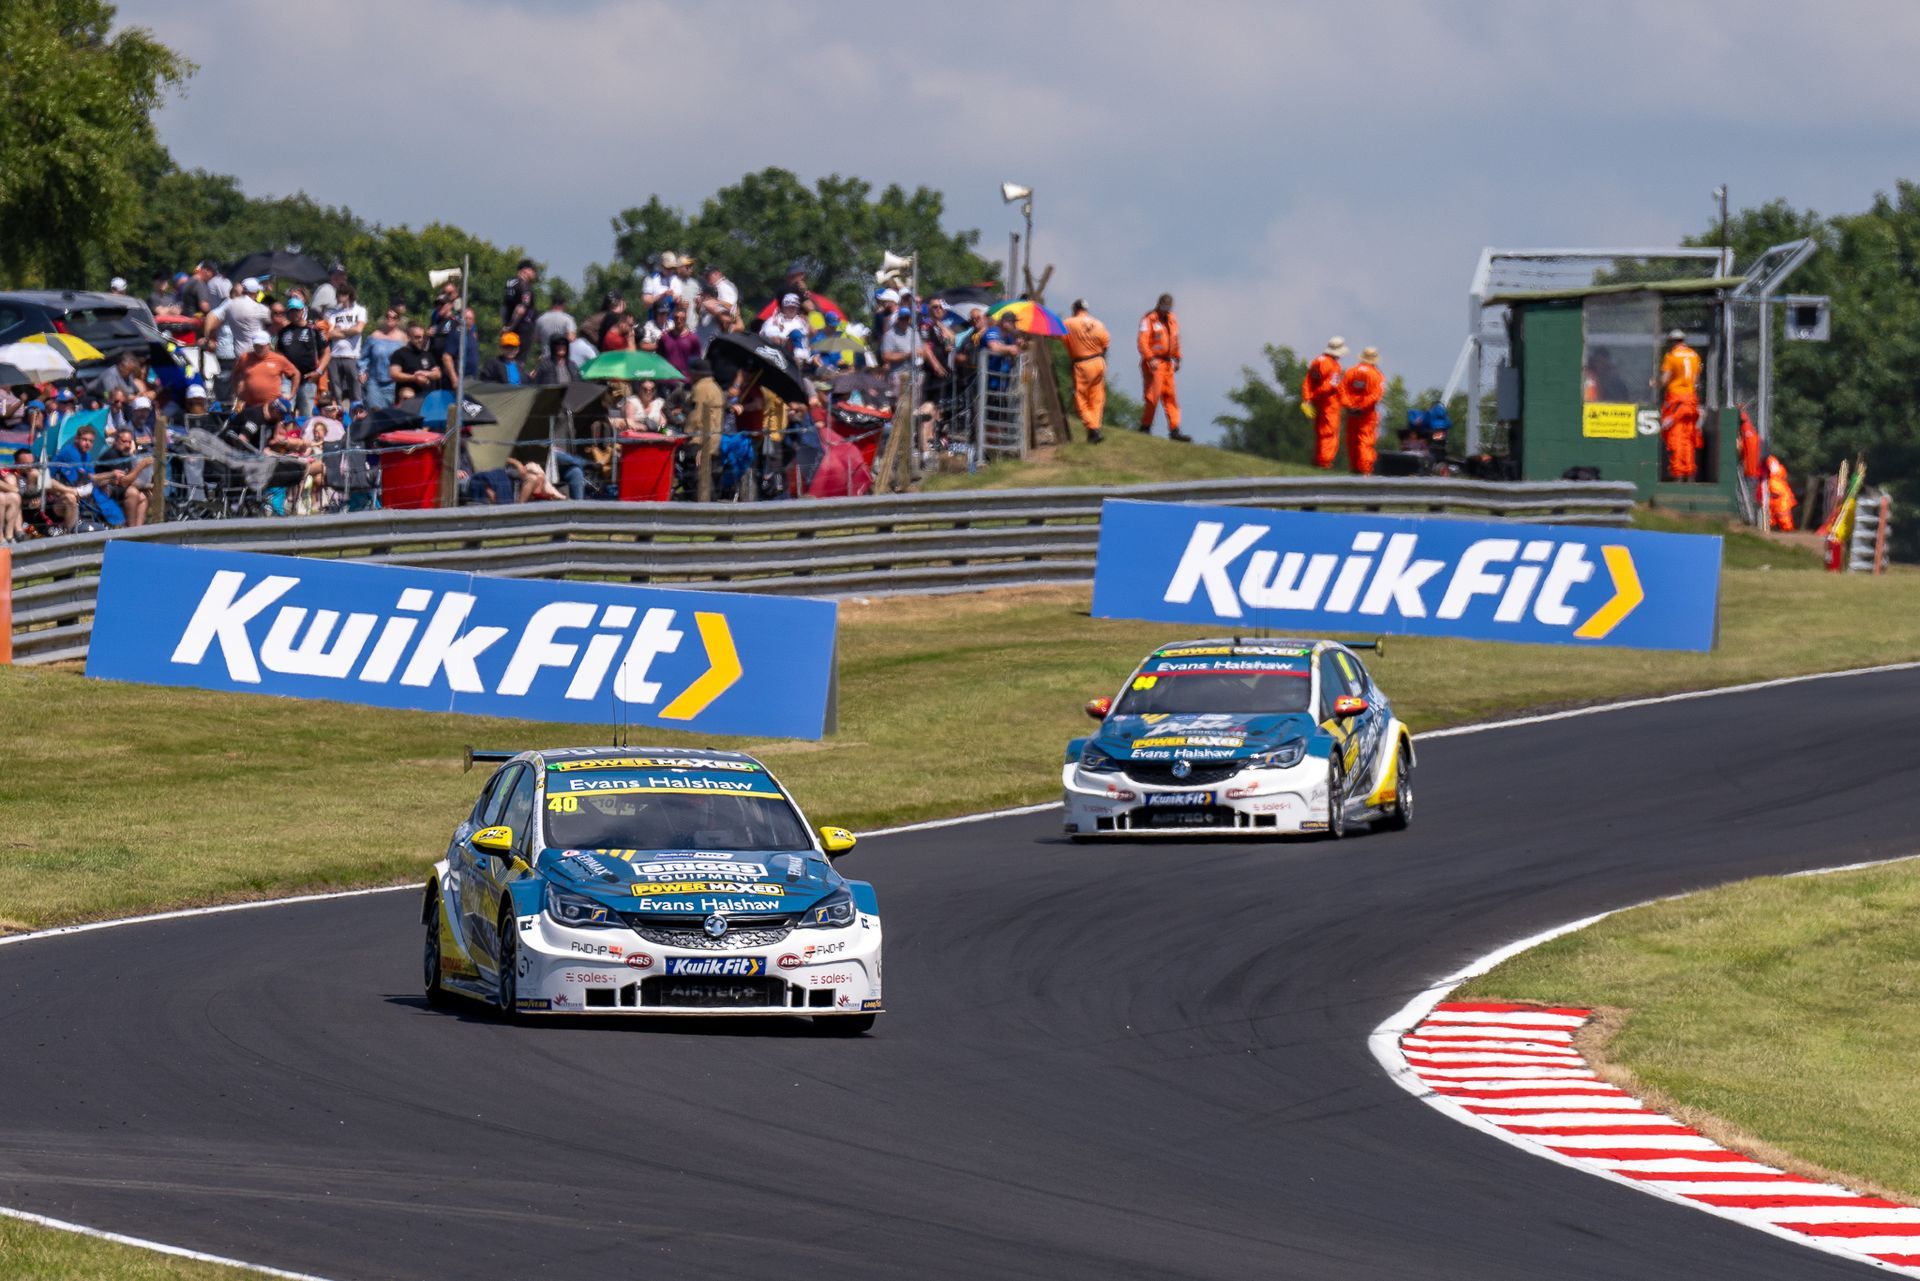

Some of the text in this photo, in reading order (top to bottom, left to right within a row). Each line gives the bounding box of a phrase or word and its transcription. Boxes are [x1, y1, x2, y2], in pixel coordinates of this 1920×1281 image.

[1637, 410, 1660, 435] 5
[1157, 660, 1293, 672] Evans Halshaw
[1133, 737, 1186, 748] POWER
[1131, 748, 1235, 758] Evans Halshaw
[562, 758, 748, 770] POWER MAXED
[569, 776, 753, 791] Evans Halshaw
[548, 796, 578, 812] 40
[641, 862, 757, 874] BRIGGS
[647, 873, 761, 882] EQUIPMENT
[636, 882, 782, 895] POWER MAXED
[639, 898, 780, 911] Evans Halshaw
[571, 941, 608, 956] FWD-IP
[628, 956, 651, 966] ABS
[781, 957, 800, 966] ABS
[577, 972, 617, 983] sales-i
[820, 973, 853, 984] sales-i
